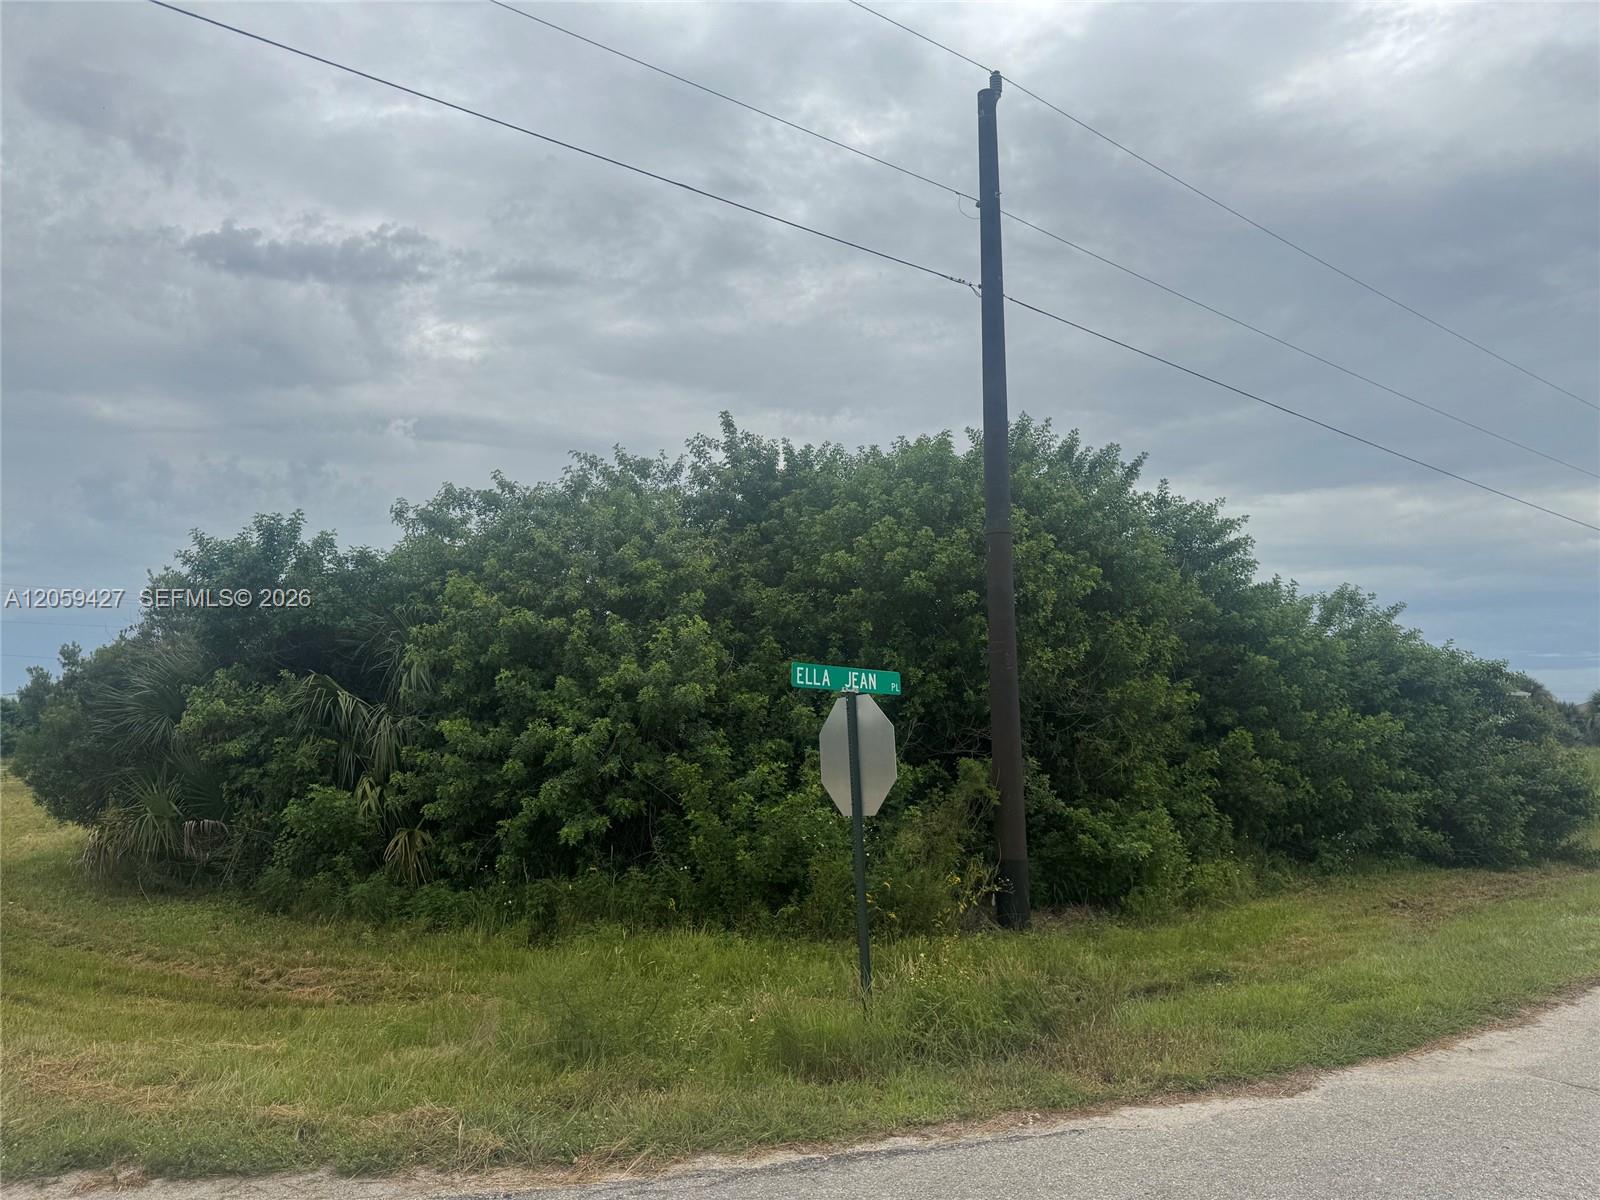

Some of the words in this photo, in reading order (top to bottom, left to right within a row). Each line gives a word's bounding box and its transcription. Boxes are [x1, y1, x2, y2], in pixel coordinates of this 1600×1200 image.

[796, 667, 831, 686] ELLA
[844, 671, 877, 690] JEAN
[891, 682, 900, 692] PL
